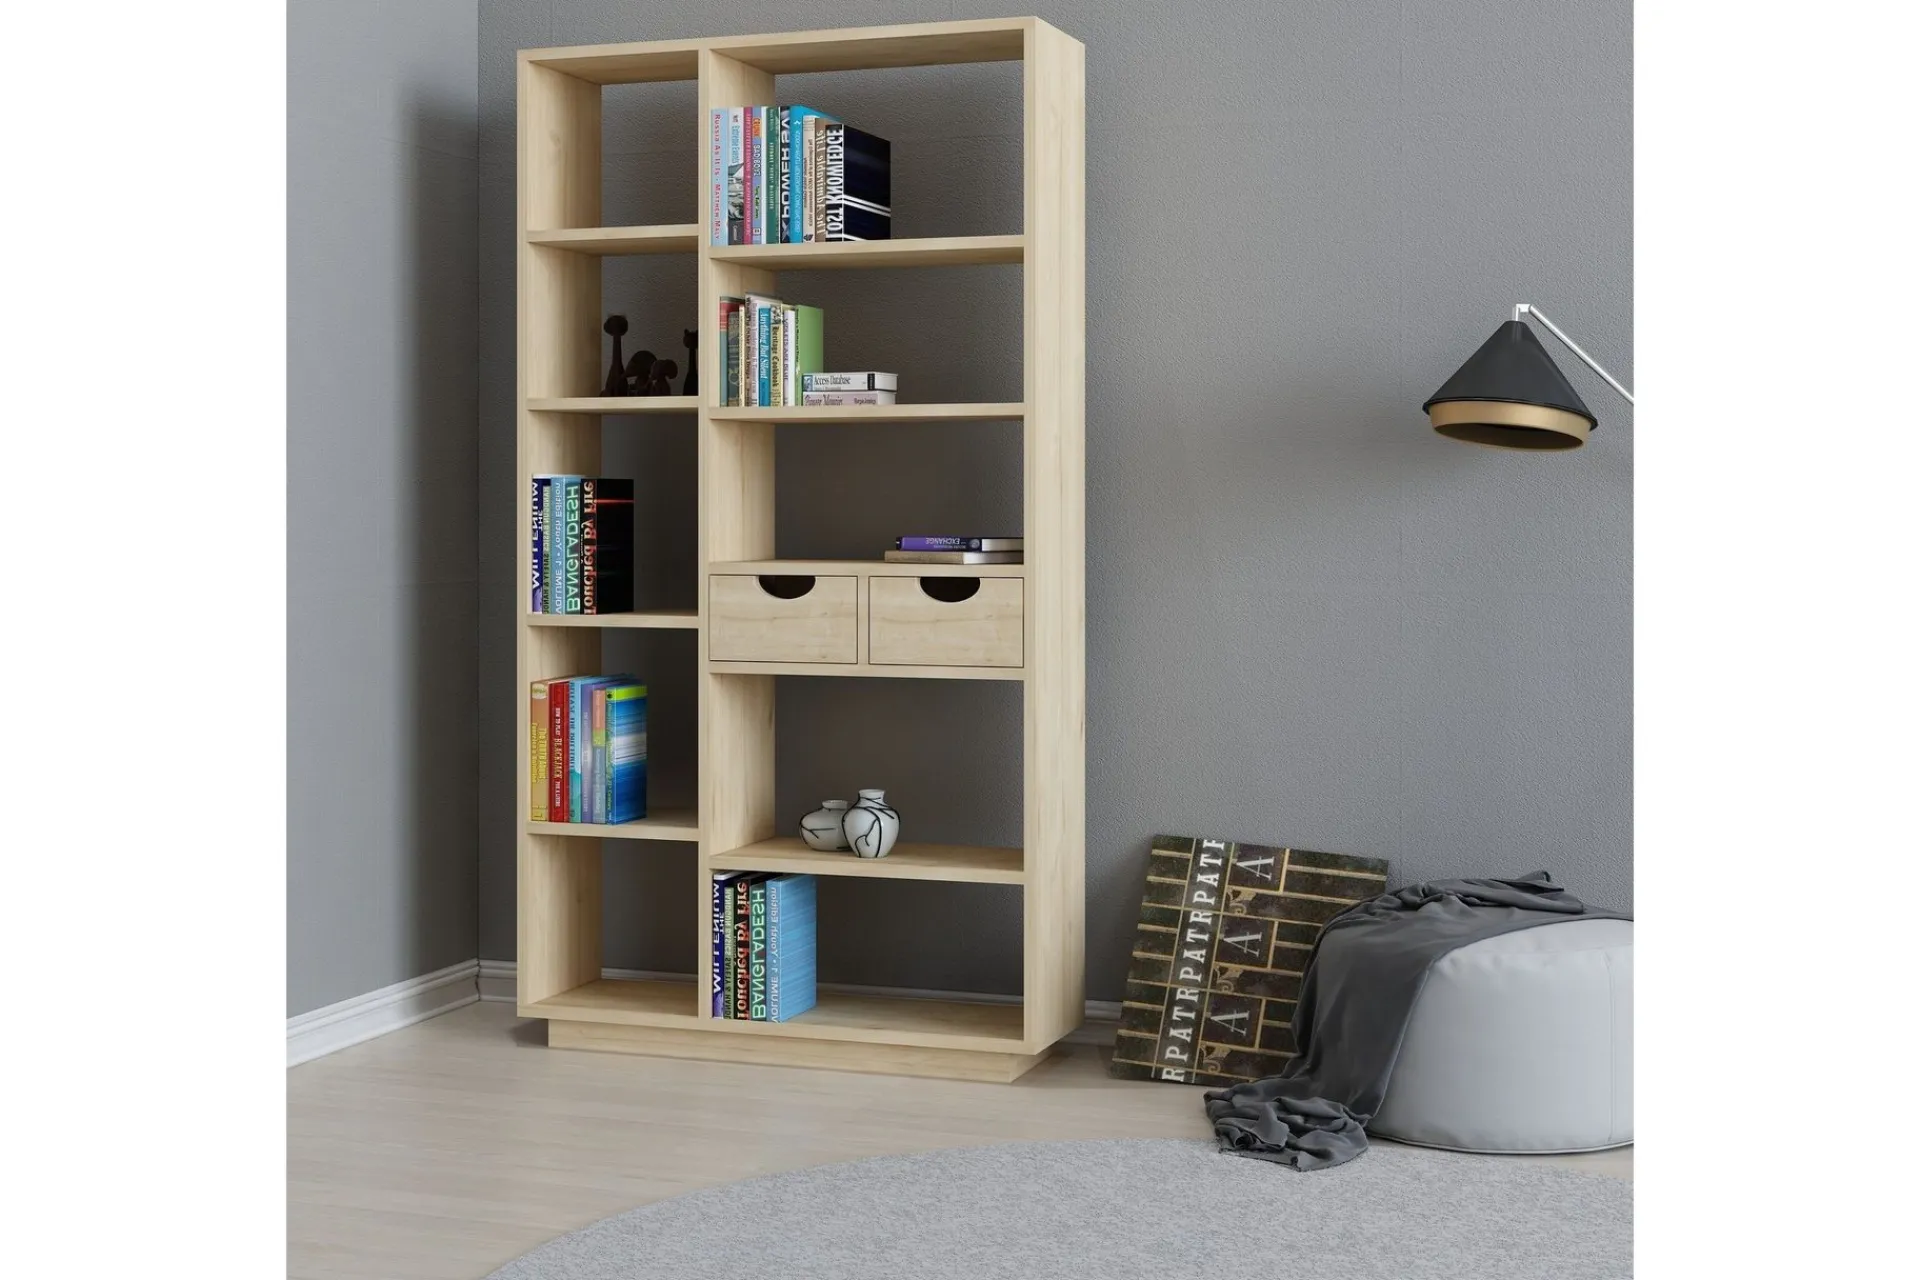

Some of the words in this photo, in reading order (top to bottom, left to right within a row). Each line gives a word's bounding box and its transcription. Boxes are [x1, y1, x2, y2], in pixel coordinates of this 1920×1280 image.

[731, 126, 740, 147] Extreme
[715, 145, 721, 154] As
[731, 147, 740, 163] Events
[760, 312, 769, 344] Anything
[760, 345, 769, 357] But
[760, 358, 769, 379] Silent
[814, 376, 830, 386] Access
[830, 375, 851, 385] Database
[554, 738, 562, 778] BLACKJACK
[1235, 856, 1275, 880] A
[1223, 931, 1262, 957] A
[1211, 1010, 1250, 1036] A
